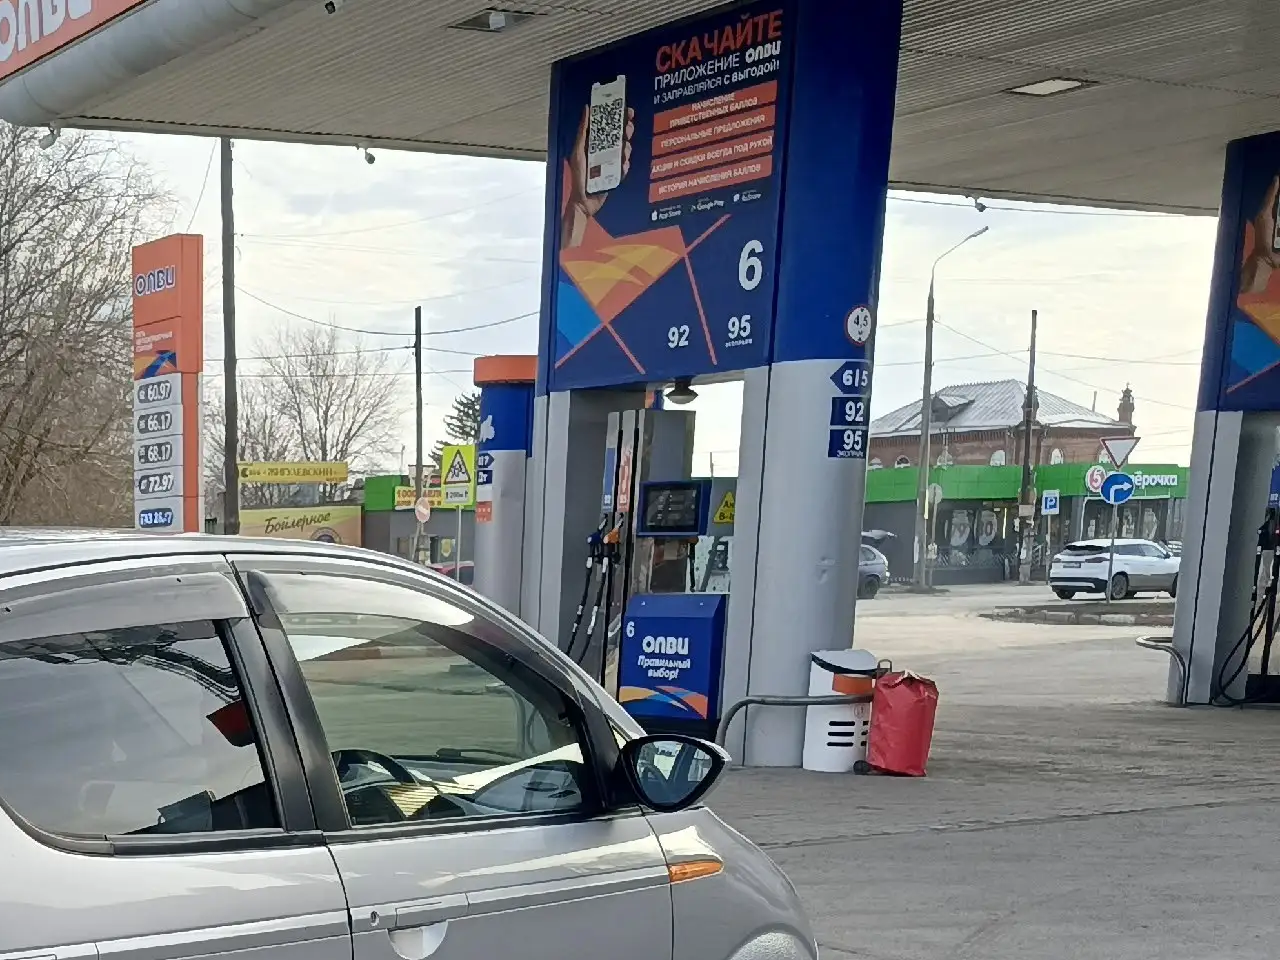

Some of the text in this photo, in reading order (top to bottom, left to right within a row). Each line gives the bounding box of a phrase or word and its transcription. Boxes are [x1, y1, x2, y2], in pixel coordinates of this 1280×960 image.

[655, 9, 783, 73] СКАЧАЙТЕ
[654, 52, 740, 90] ПРИЛОЖЕНИЕ
[738, 239, 764, 291] 6
[668, 325, 690, 348] 92
[728, 314, 751, 339] 95
[845, 401, 864, 422] 92
[843, 429, 862, 450] 95
[264, 512, 331, 534] Бойлерное
[626, 621, 635, 638] 6
[637, 654, 691, 669] Правильный
